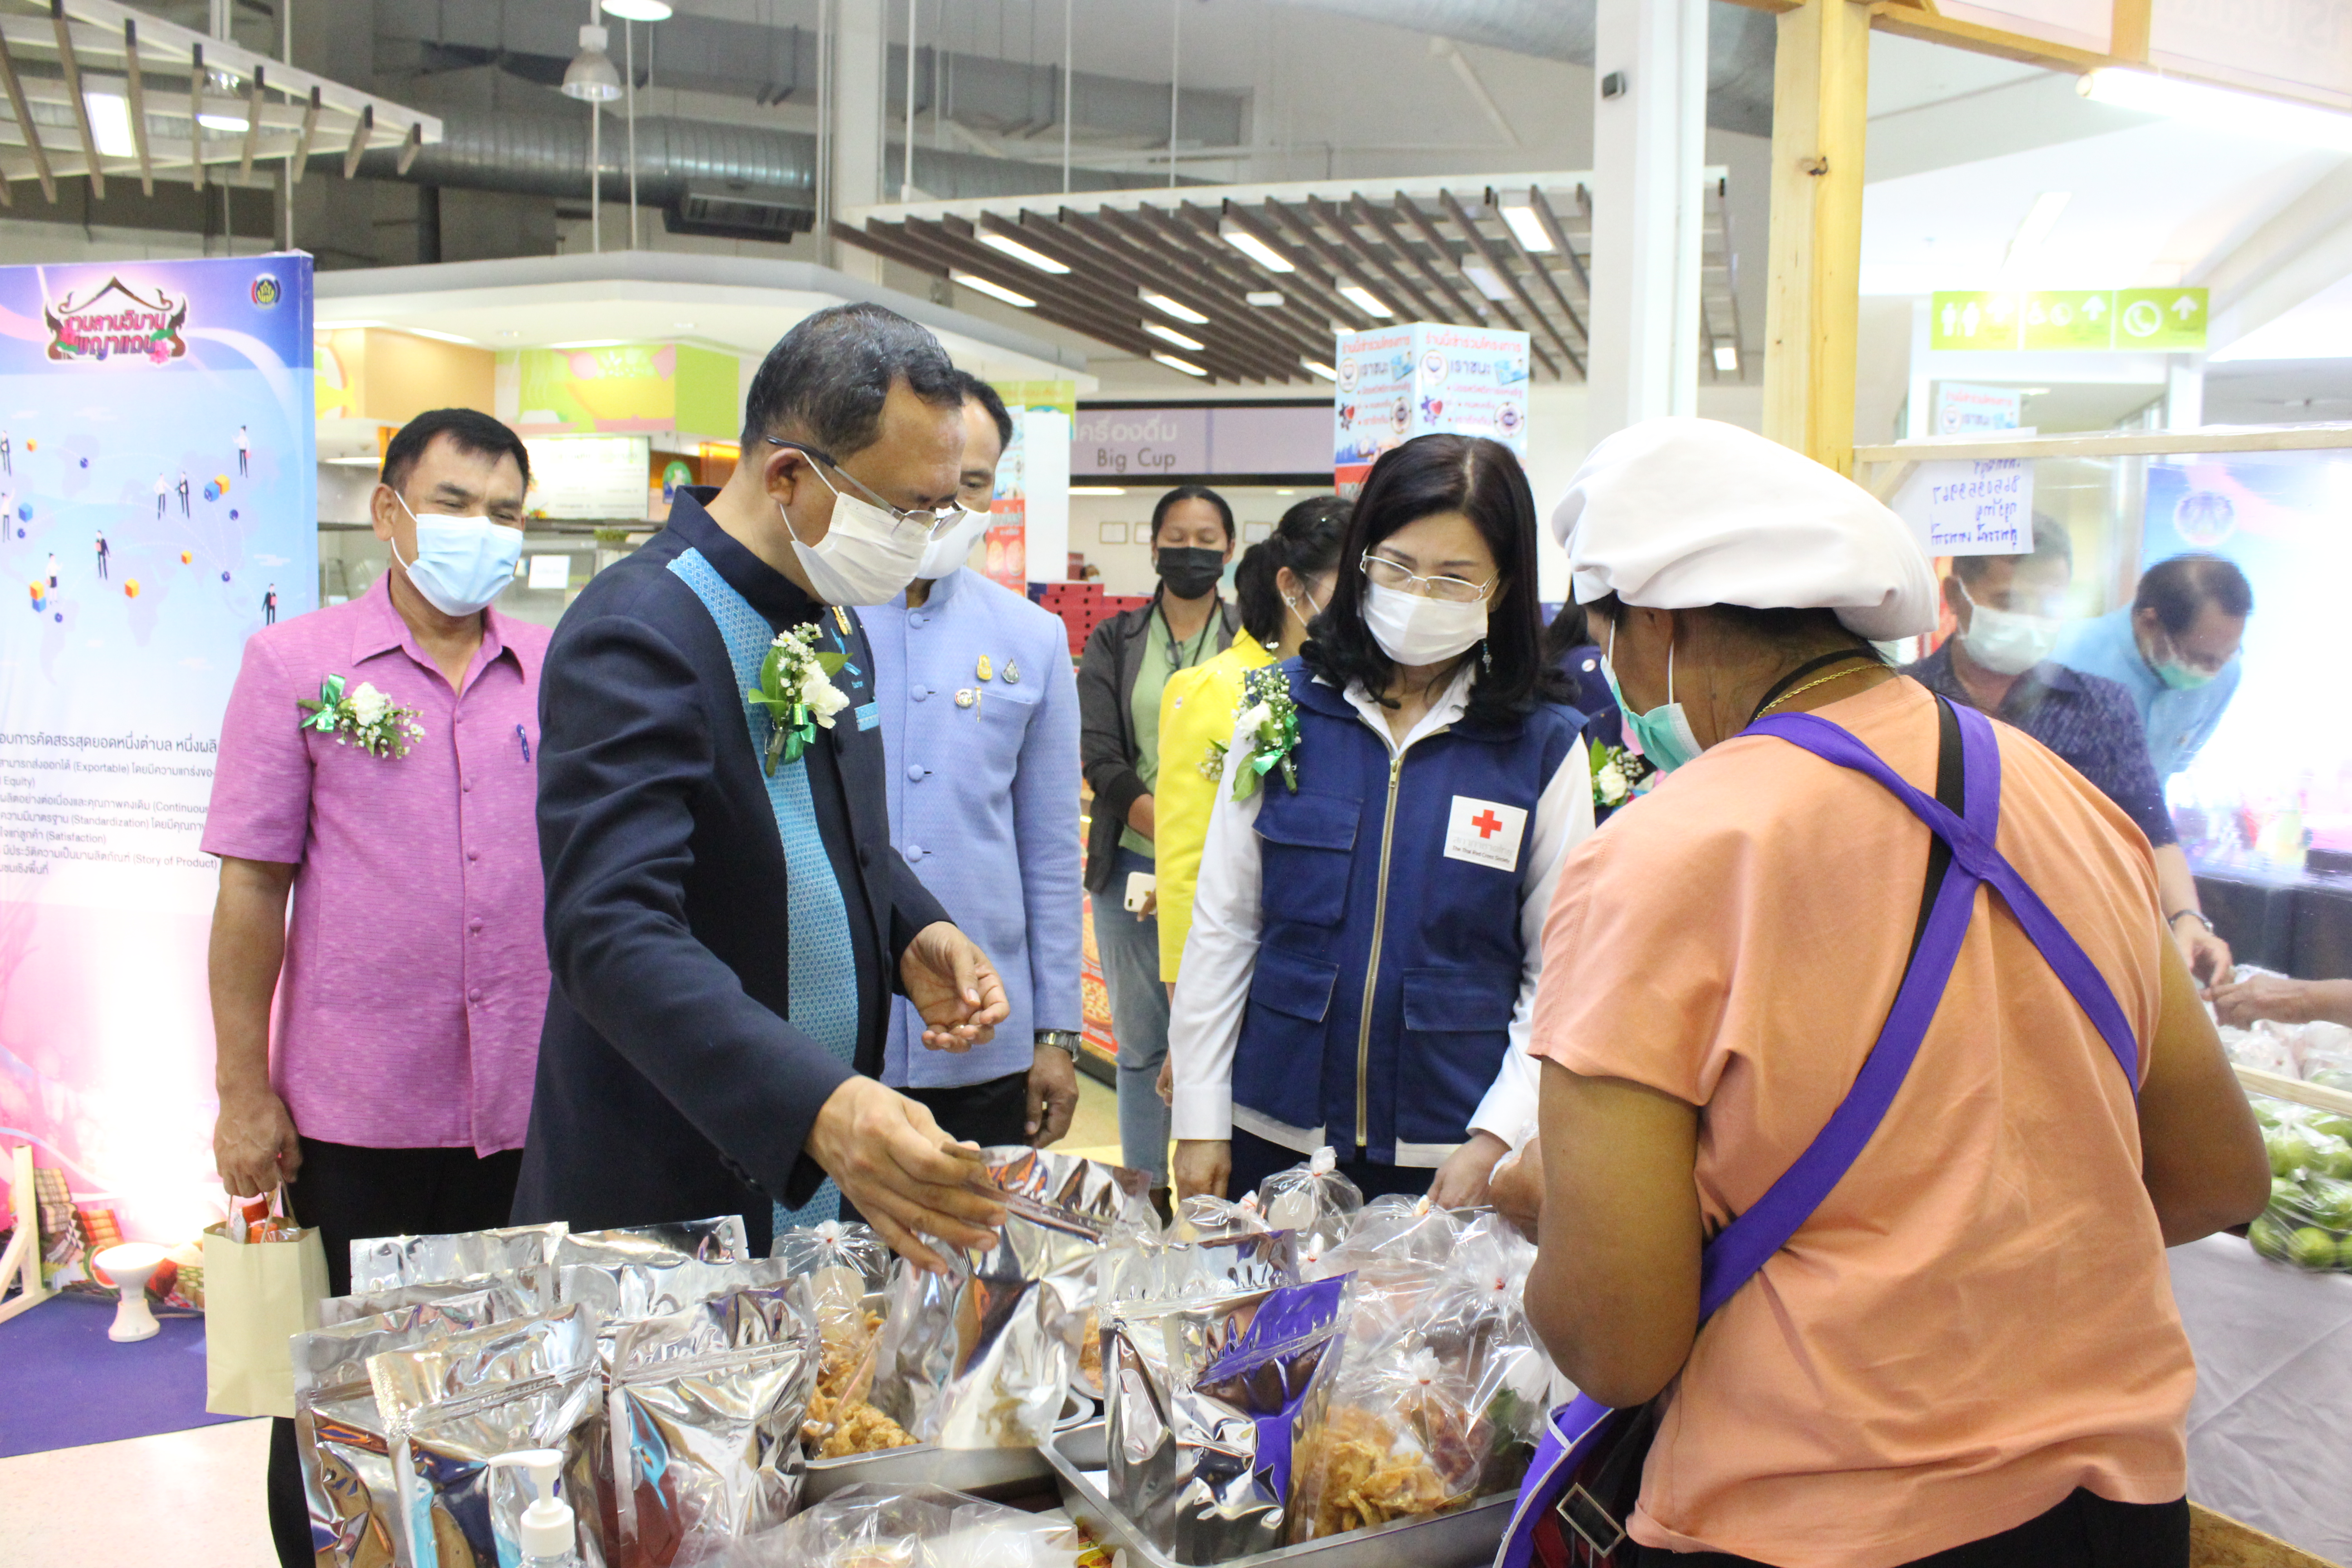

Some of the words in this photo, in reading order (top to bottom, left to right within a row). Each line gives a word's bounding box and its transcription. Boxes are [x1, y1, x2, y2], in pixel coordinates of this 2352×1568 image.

[1097, 448, 1127, 472] Big
[1137, 448, 1176, 473] Cup
[74, 761, 129, 775] (Exportable)
[4, 776, 35, 788] Equity)
[71, 814, 149, 830] (Standardization)
[46, 831, 106, 844] (Satisfaction)
[133, 854, 161, 867] (Story
[164, 856, 173, 865] of
[176, 857, 217, 869] Product)
